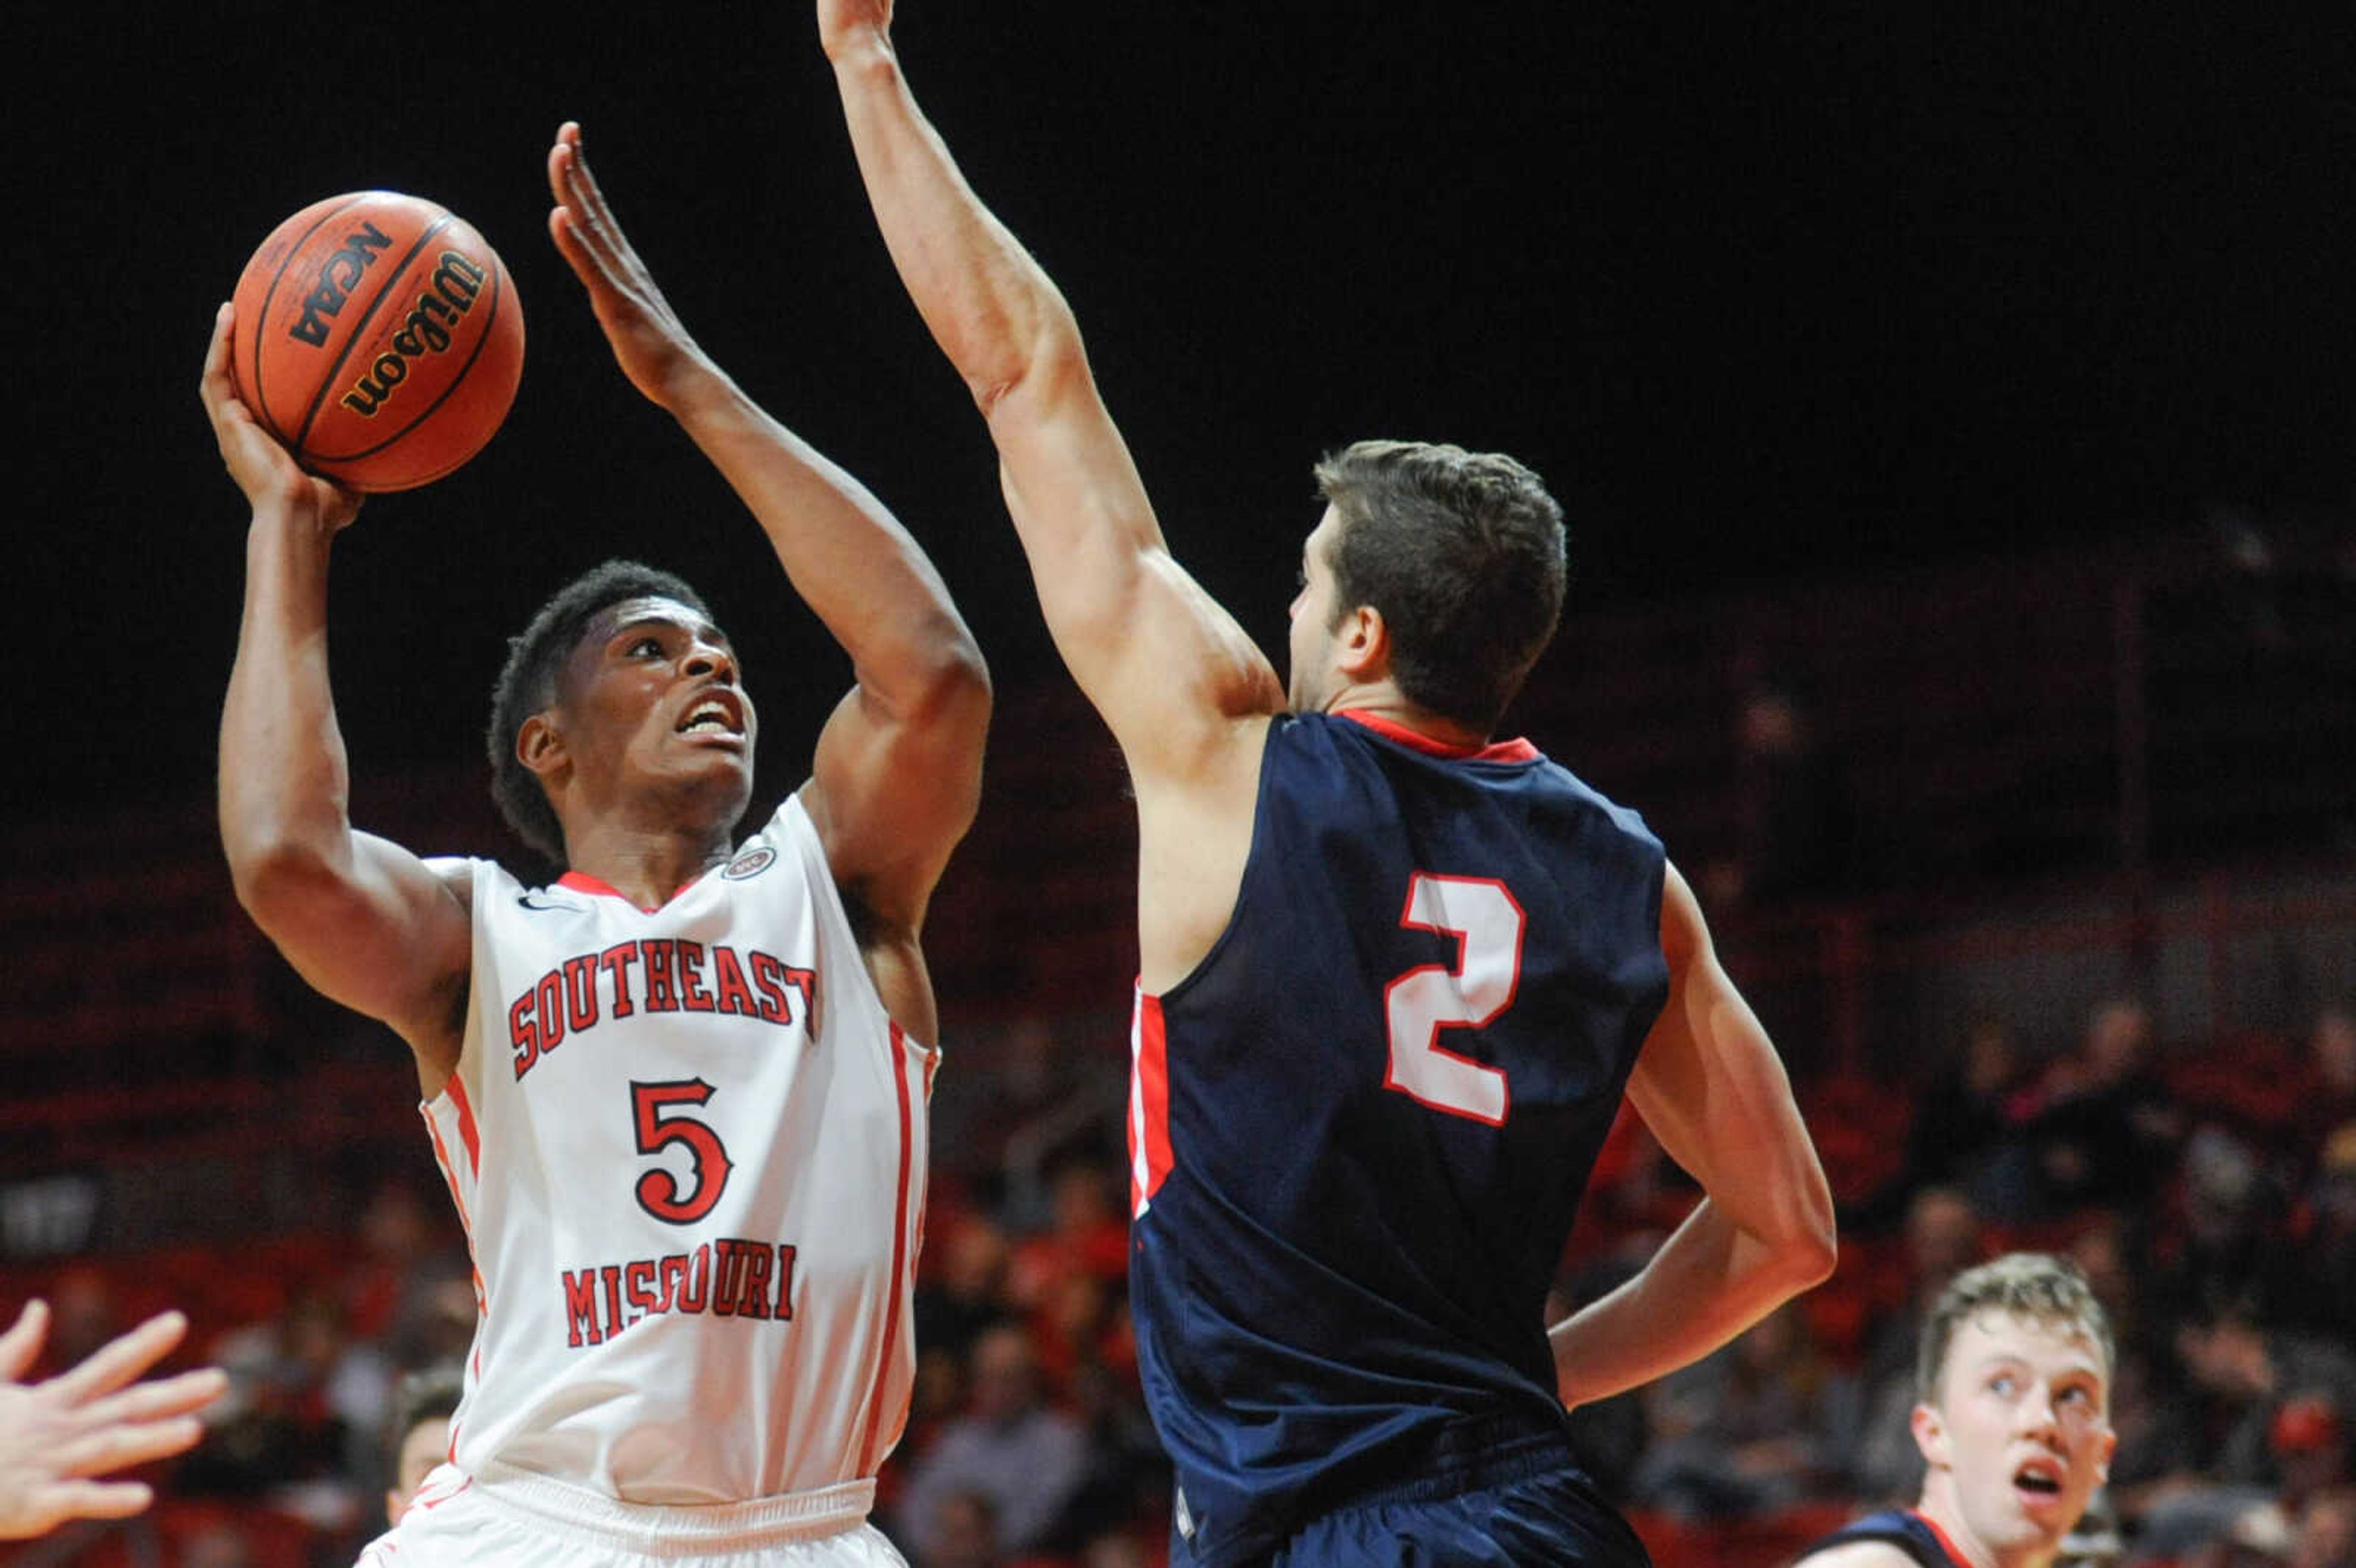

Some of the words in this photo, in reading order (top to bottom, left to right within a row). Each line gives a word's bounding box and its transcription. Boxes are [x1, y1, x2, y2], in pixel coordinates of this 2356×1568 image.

[289, 221, 392, 348] NCAA
[341, 250, 487, 417] Wilson
[509, 938, 817, 1082] SOUTHEAST
[1382, 869, 1528, 1128] 2
[629, 1077, 734, 1225] 5
[562, 1239, 796, 1348] MISSOURI
